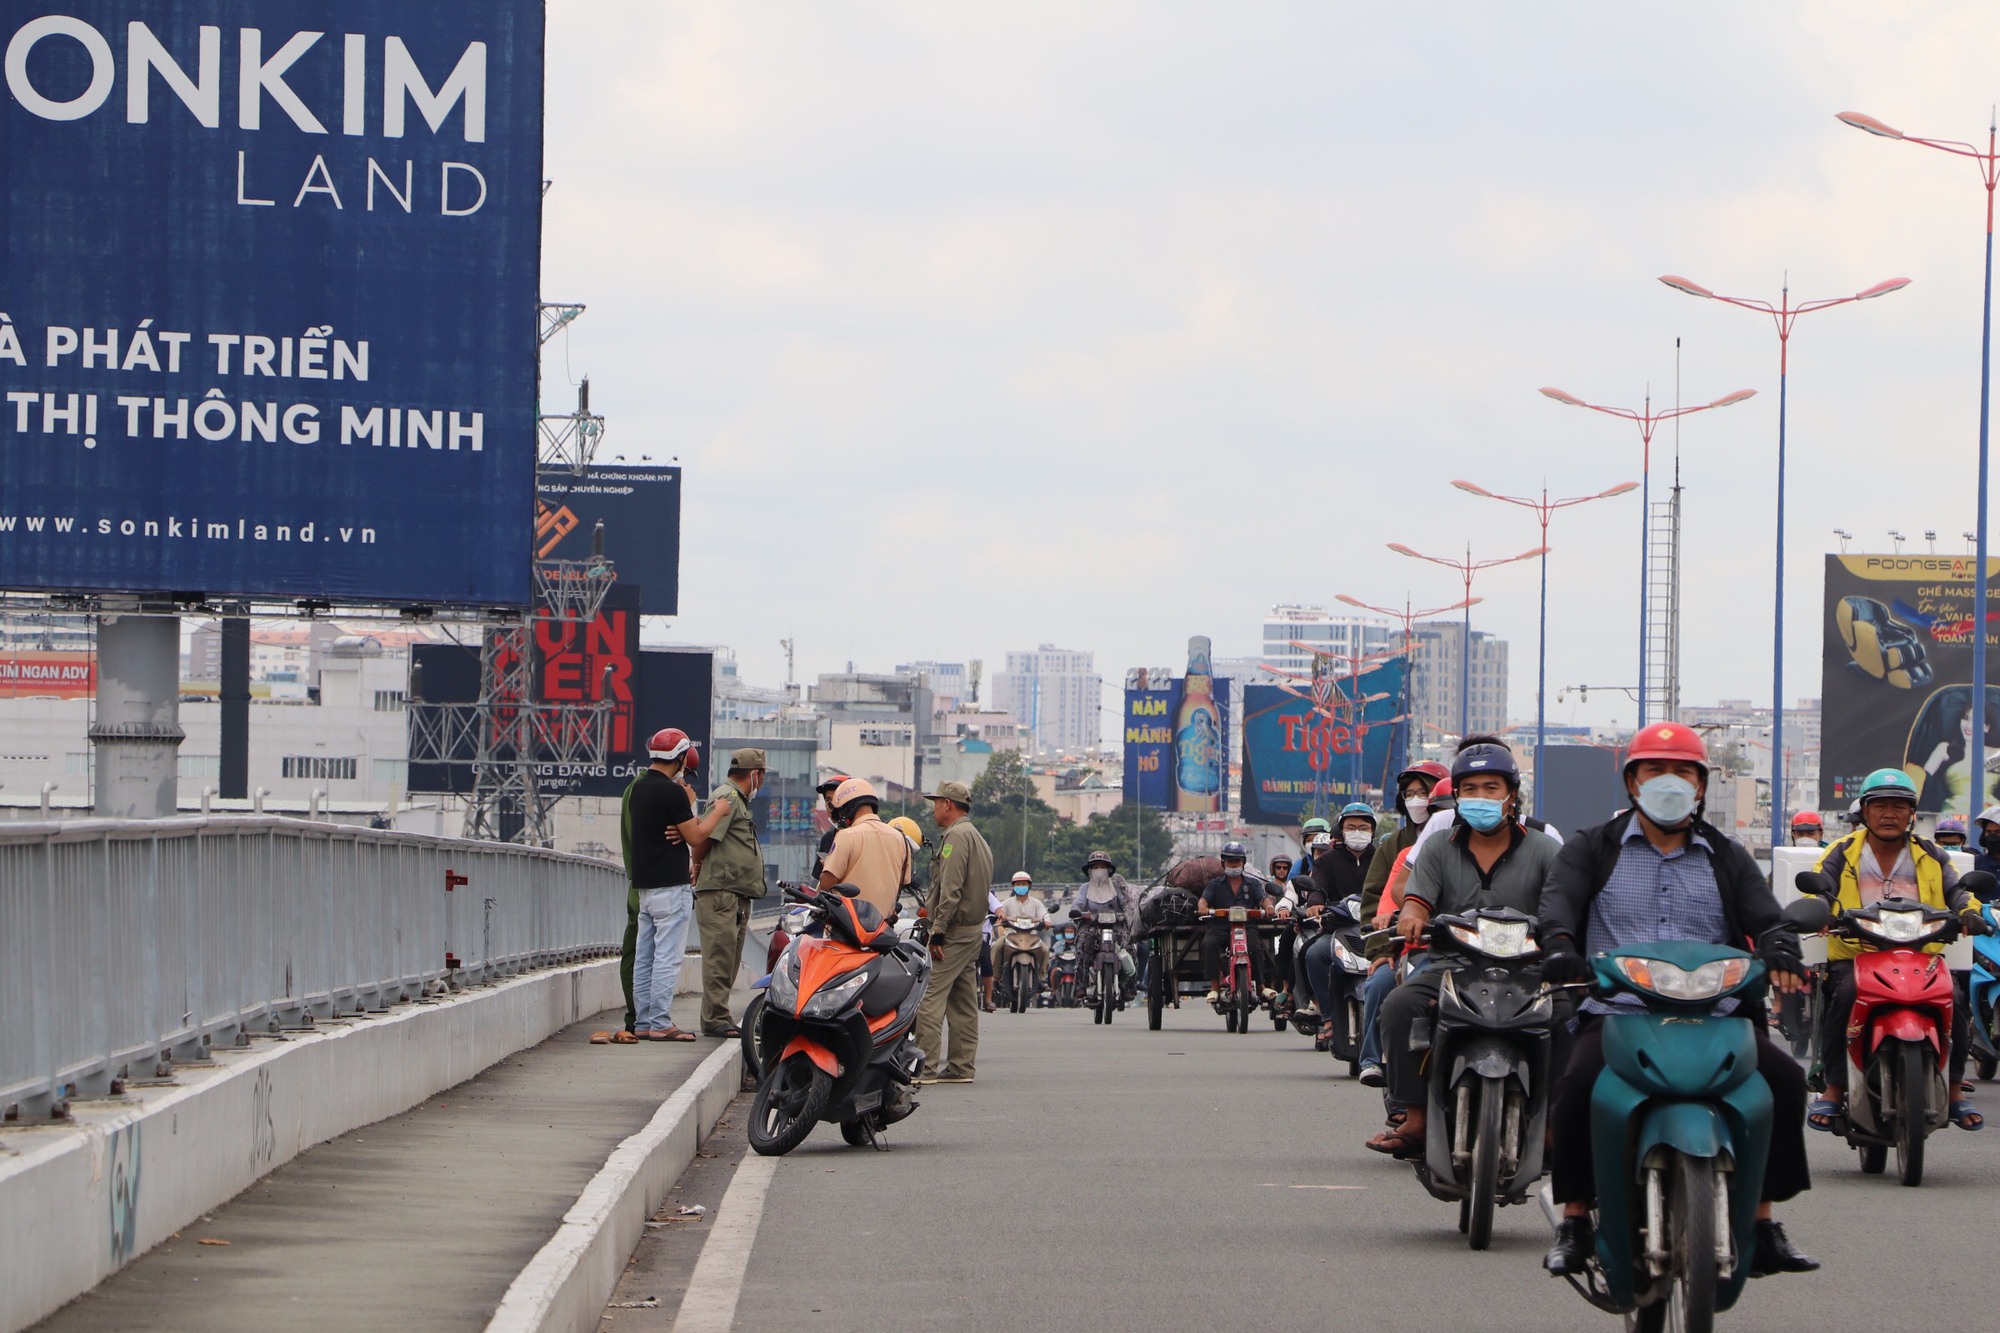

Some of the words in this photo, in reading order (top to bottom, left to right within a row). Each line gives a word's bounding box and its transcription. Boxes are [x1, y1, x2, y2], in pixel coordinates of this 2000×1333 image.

[4, 14, 487, 143] ONKIM
[237, 150, 487, 216] LAND
[46, 319, 191, 373] PHÁT
[208, 325, 369, 382] TRIỂN
[6, 392, 98, 449] THỊ
[117, 387, 321, 445] THÔNG
[340, 406, 484, 451] MINH
[0, 512, 376, 544] www.sonkimland.vn
[1945, 588, 2000, 598] MASSGE
[1946, 613, 1964, 622] VAI
[0, 665, 19, 678] IM
[22, 666, 60, 679] NGAN
[62, 667, 89, 679] ADV
[1132, 695, 1167, 716] NĂM
[1126, 724, 1172, 743] MÃNH
[1277, 710, 1370, 771] Tiger
[1137, 749, 1160, 772] HỔ
[1292, 779, 1319, 794] THỨ
